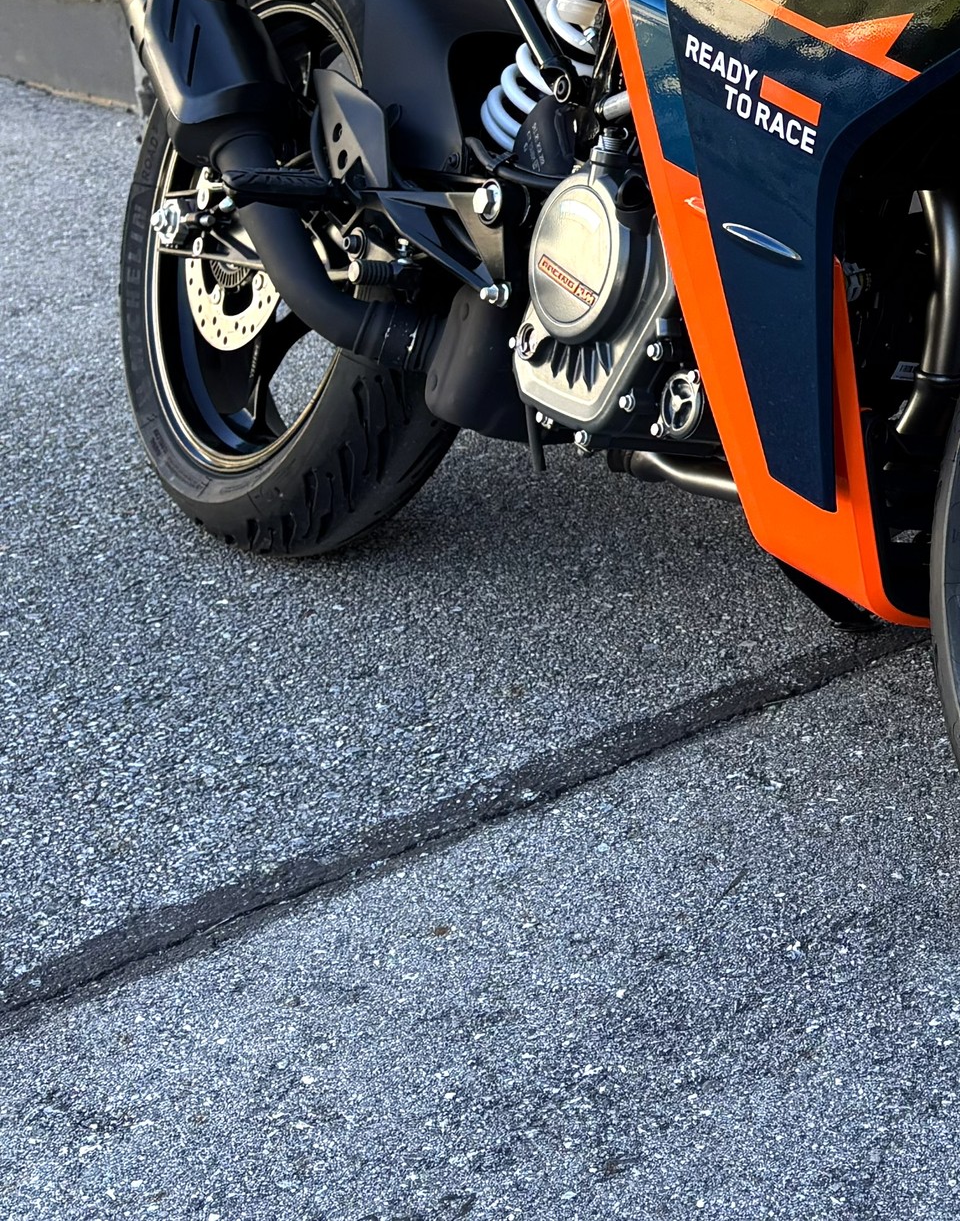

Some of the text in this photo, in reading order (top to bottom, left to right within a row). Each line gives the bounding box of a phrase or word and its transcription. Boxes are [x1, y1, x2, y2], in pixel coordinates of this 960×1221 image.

[685, 33, 758, 91] READY
[724, 84, 817, 155] TO RACE
[541, 258, 576, 289] RACING
